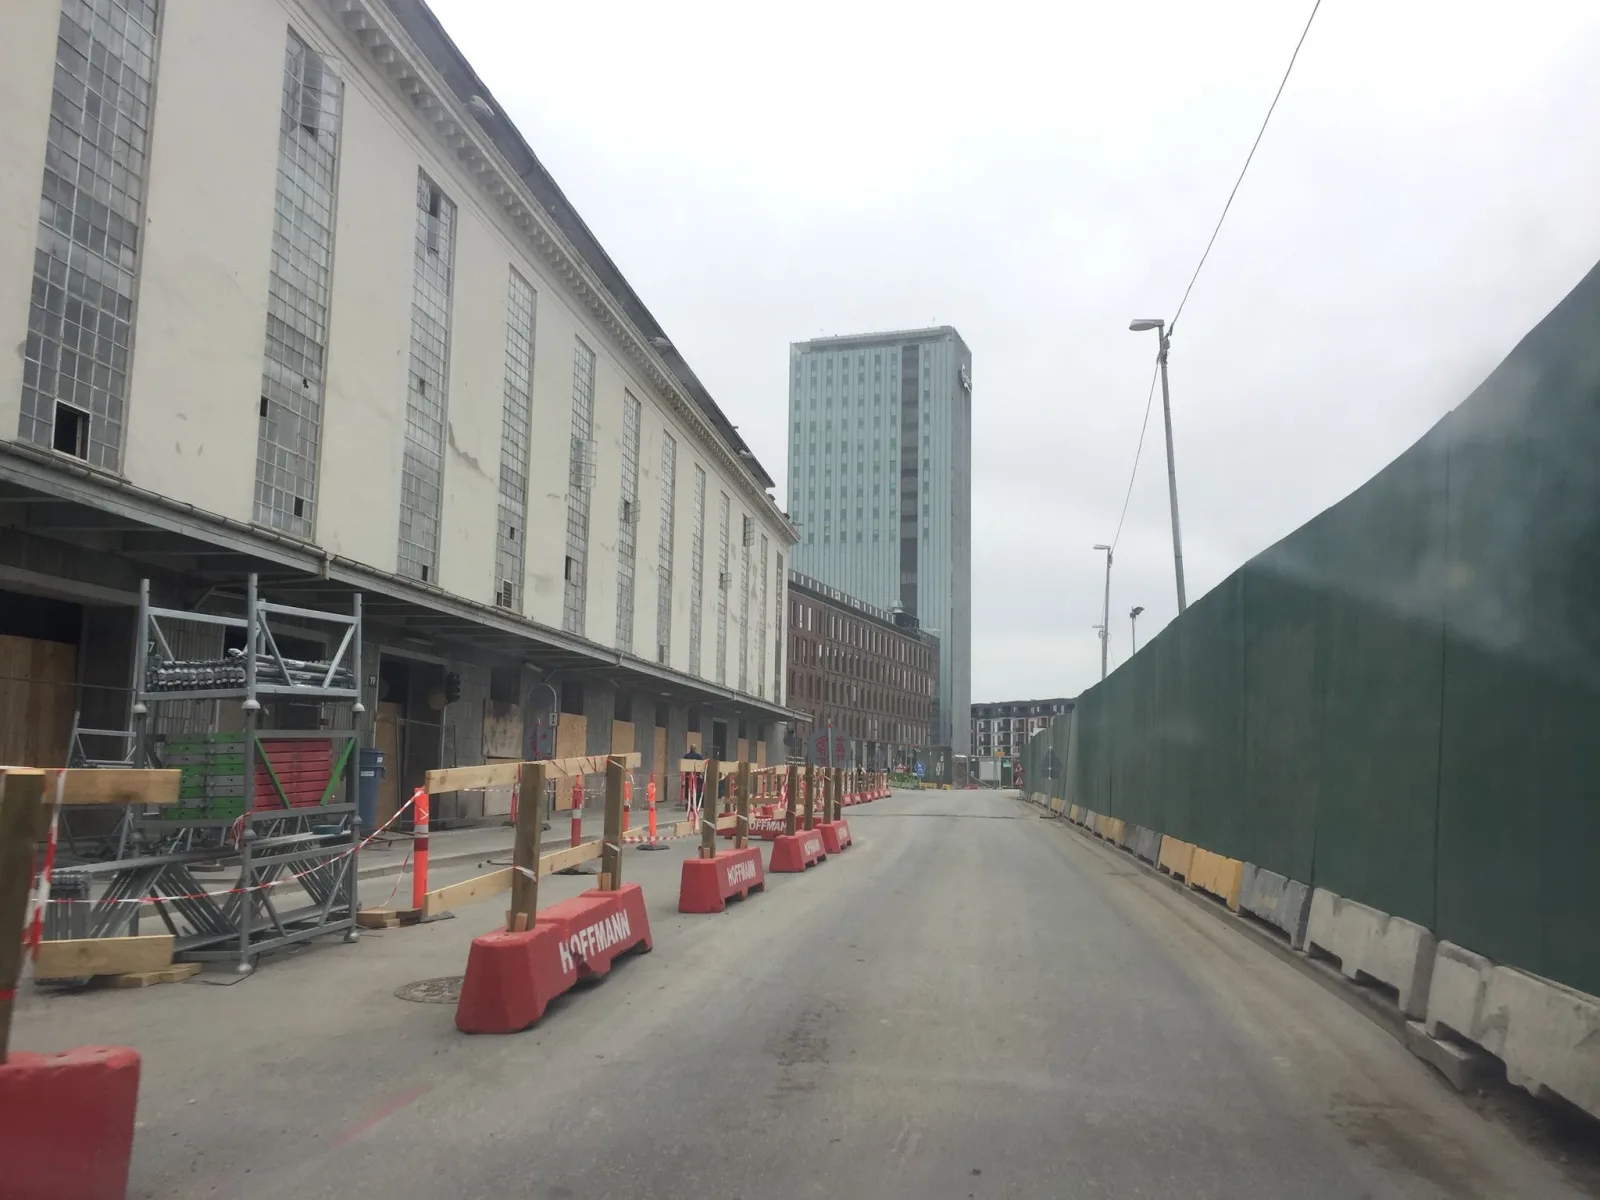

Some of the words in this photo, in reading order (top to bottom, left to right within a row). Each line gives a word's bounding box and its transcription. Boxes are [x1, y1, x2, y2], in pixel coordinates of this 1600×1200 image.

[748, 820, 788, 832] OFFMAN
[726, 859, 756, 887] HOFFMANN
[559, 908, 631, 974] HOFFMANN
